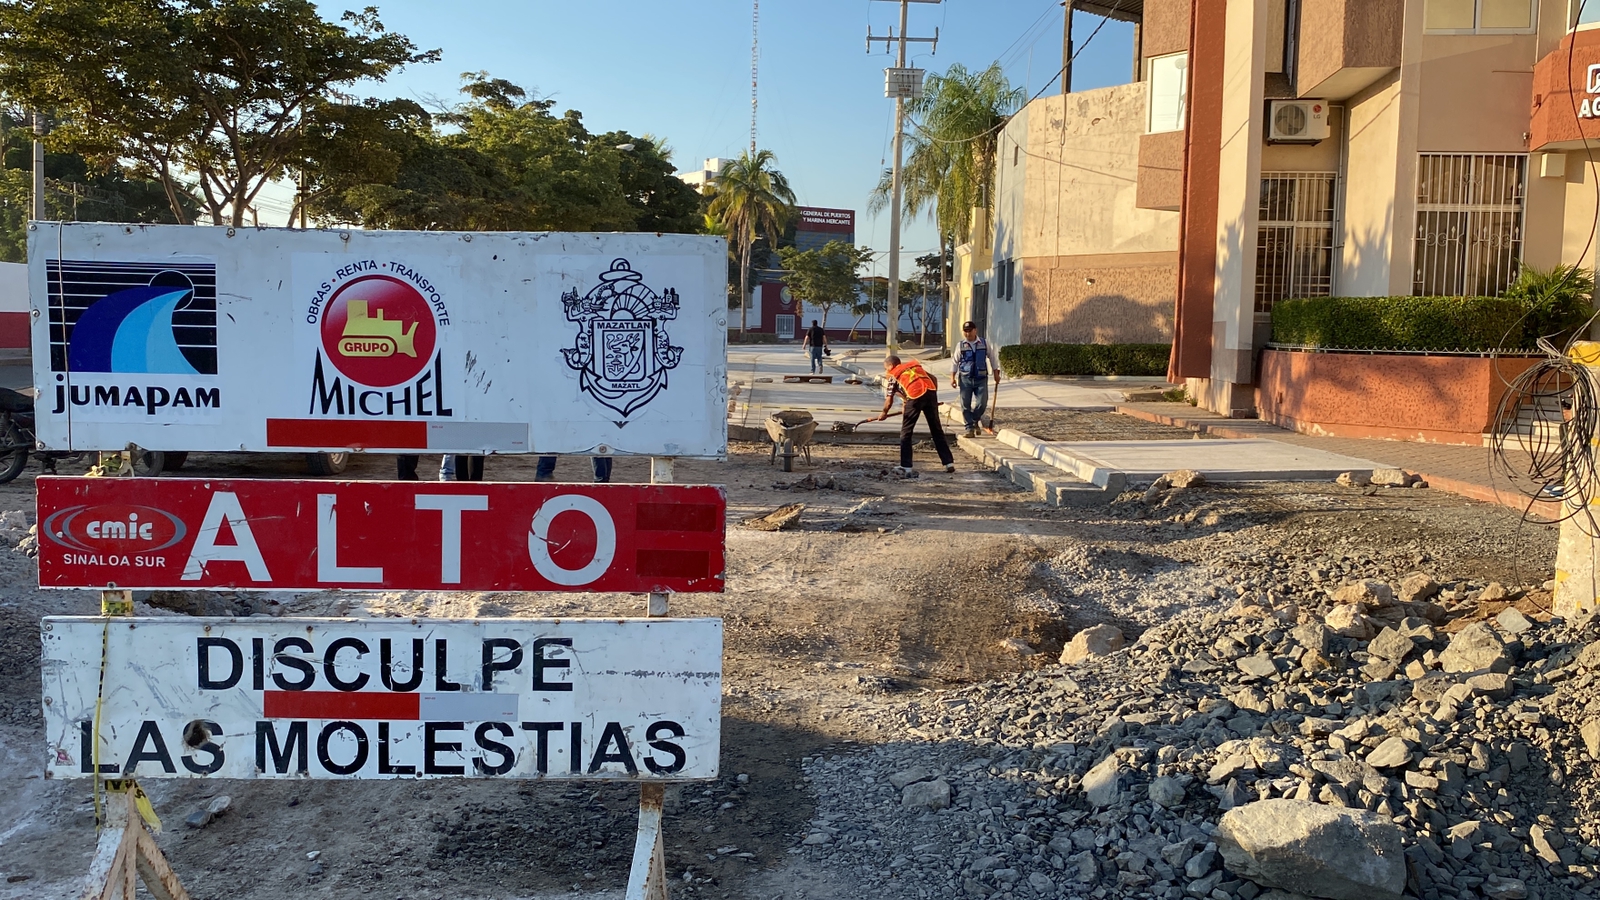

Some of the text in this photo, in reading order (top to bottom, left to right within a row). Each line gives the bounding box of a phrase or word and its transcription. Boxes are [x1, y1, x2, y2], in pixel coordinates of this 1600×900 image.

[306, 259, 450, 327] OBRAS RENTA TRANSPORTE
[344, 342, 389, 353] GRUPO
[309, 346, 453, 417] MICHEL
[86, 512, 153, 541] cmic
[180, 490, 617, 586] ALTO
[63, 553, 166, 568] SINALOA SUR
[197, 636, 573, 693] DISCULPE
[81, 720, 687, 777] LAS MOLESTIAS
